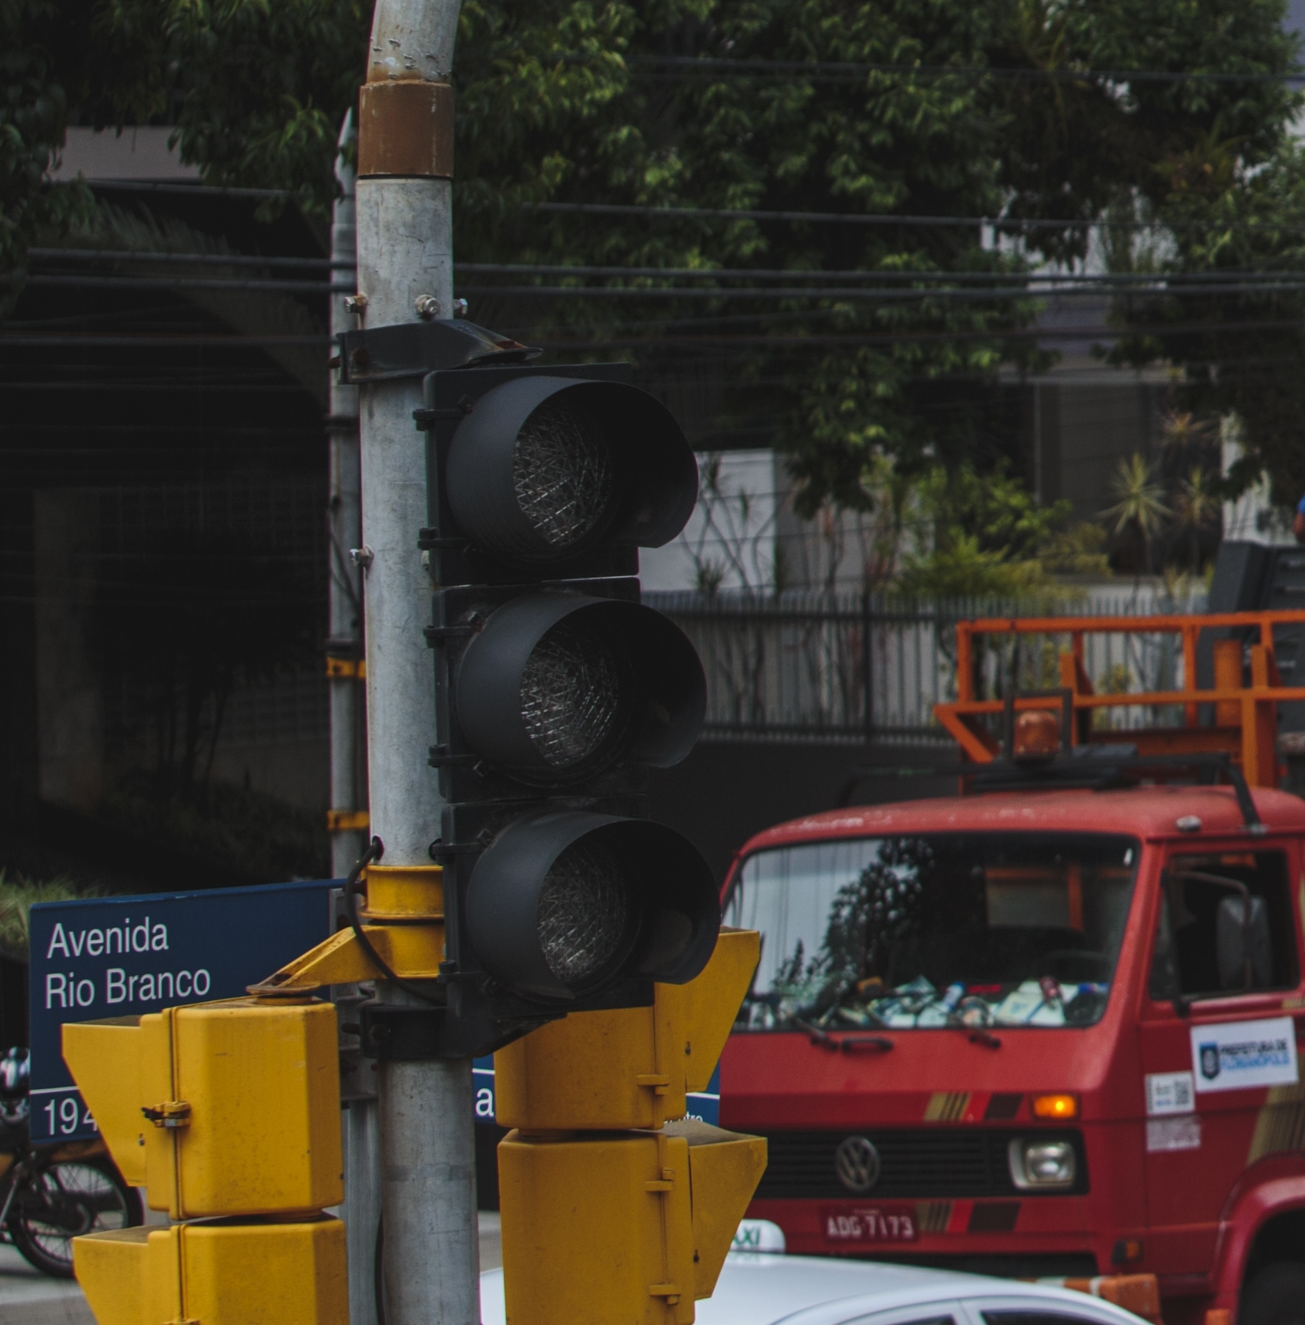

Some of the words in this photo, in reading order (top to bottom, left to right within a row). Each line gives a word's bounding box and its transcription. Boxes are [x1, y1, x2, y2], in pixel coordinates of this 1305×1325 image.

[46, 916, 169, 959] Avenida
[46, 972, 95, 1010] Rio
[106, 967, 211, 1004] Branco
